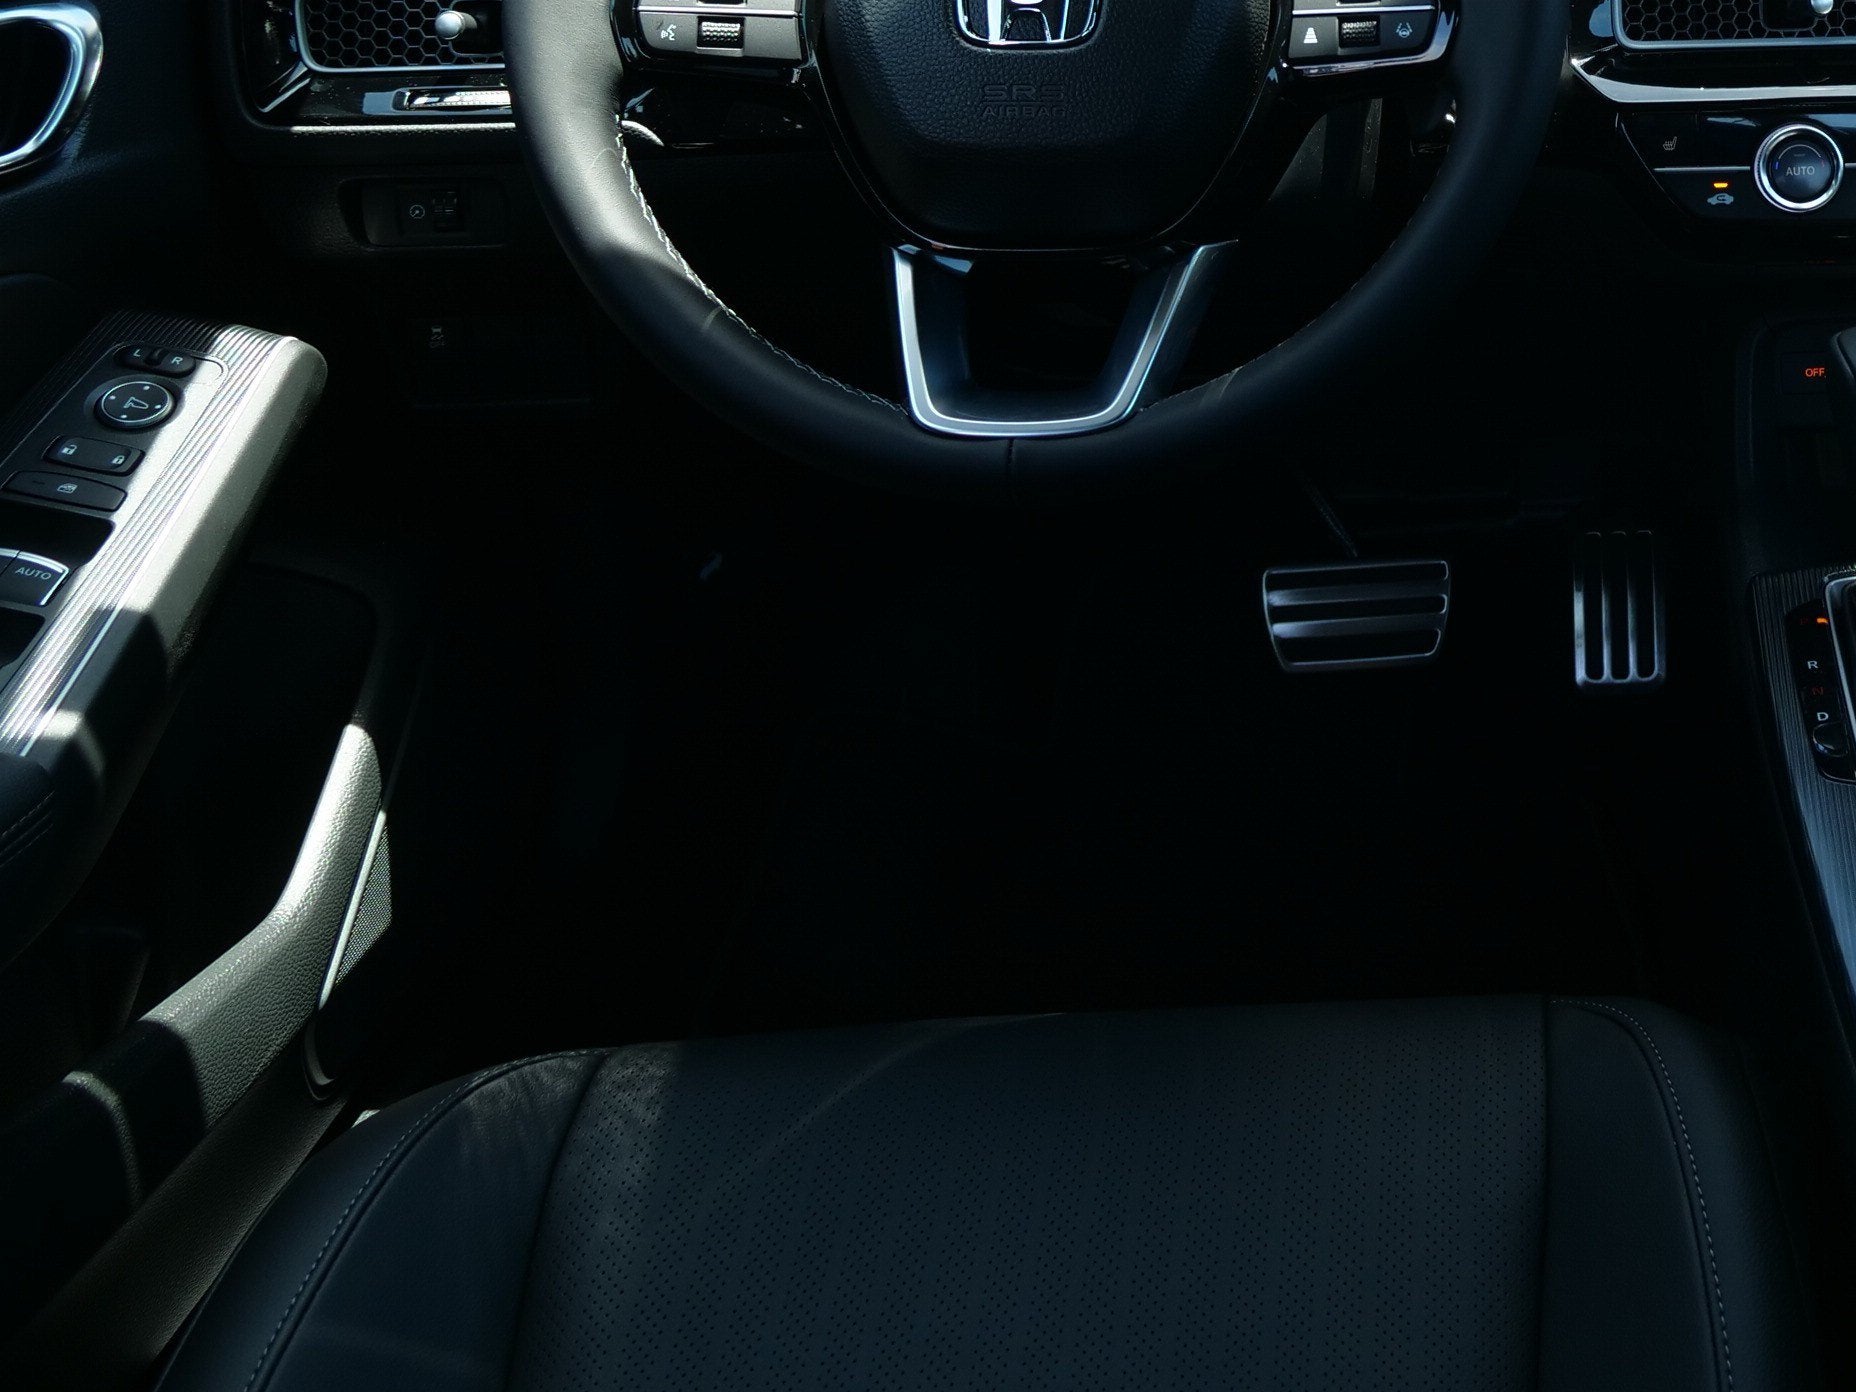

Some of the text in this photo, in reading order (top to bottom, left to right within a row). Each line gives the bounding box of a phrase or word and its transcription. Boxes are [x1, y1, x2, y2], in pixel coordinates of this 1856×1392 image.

[979, 83, 1066, 103] SRS
[979, 104, 1068, 117] AIRBAG
[1786, 166, 1815, 176] AUTO
[132, 348, 184, 365] L R
[1804, 366, 1827, 378] OFF
[14, 565, 52, 581] AUTO
[1806, 660, 1819, 670] R
[1816, 711, 1830, 722] D
